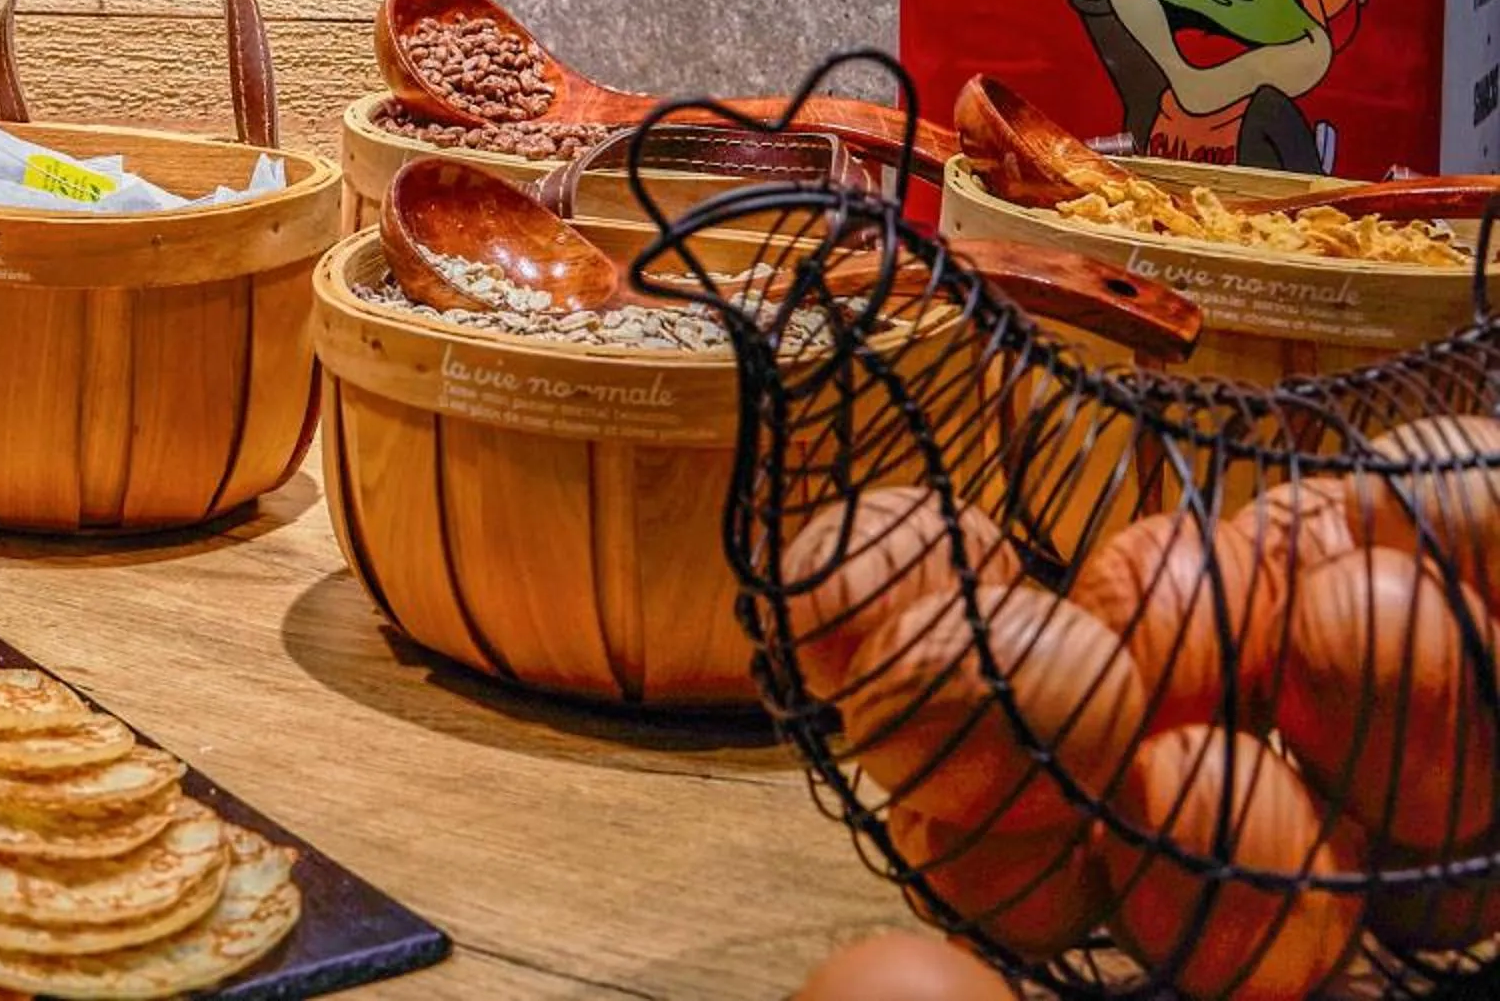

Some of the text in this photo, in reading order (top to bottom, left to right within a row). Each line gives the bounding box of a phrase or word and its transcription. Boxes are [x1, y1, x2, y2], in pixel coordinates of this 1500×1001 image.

[1124, 246, 1159, 278] la
[1164, 258, 1213, 287] vie
[1220, 272, 1363, 307] normale
[440, 343, 471, 380] la
[474, 359, 521, 389] vie
